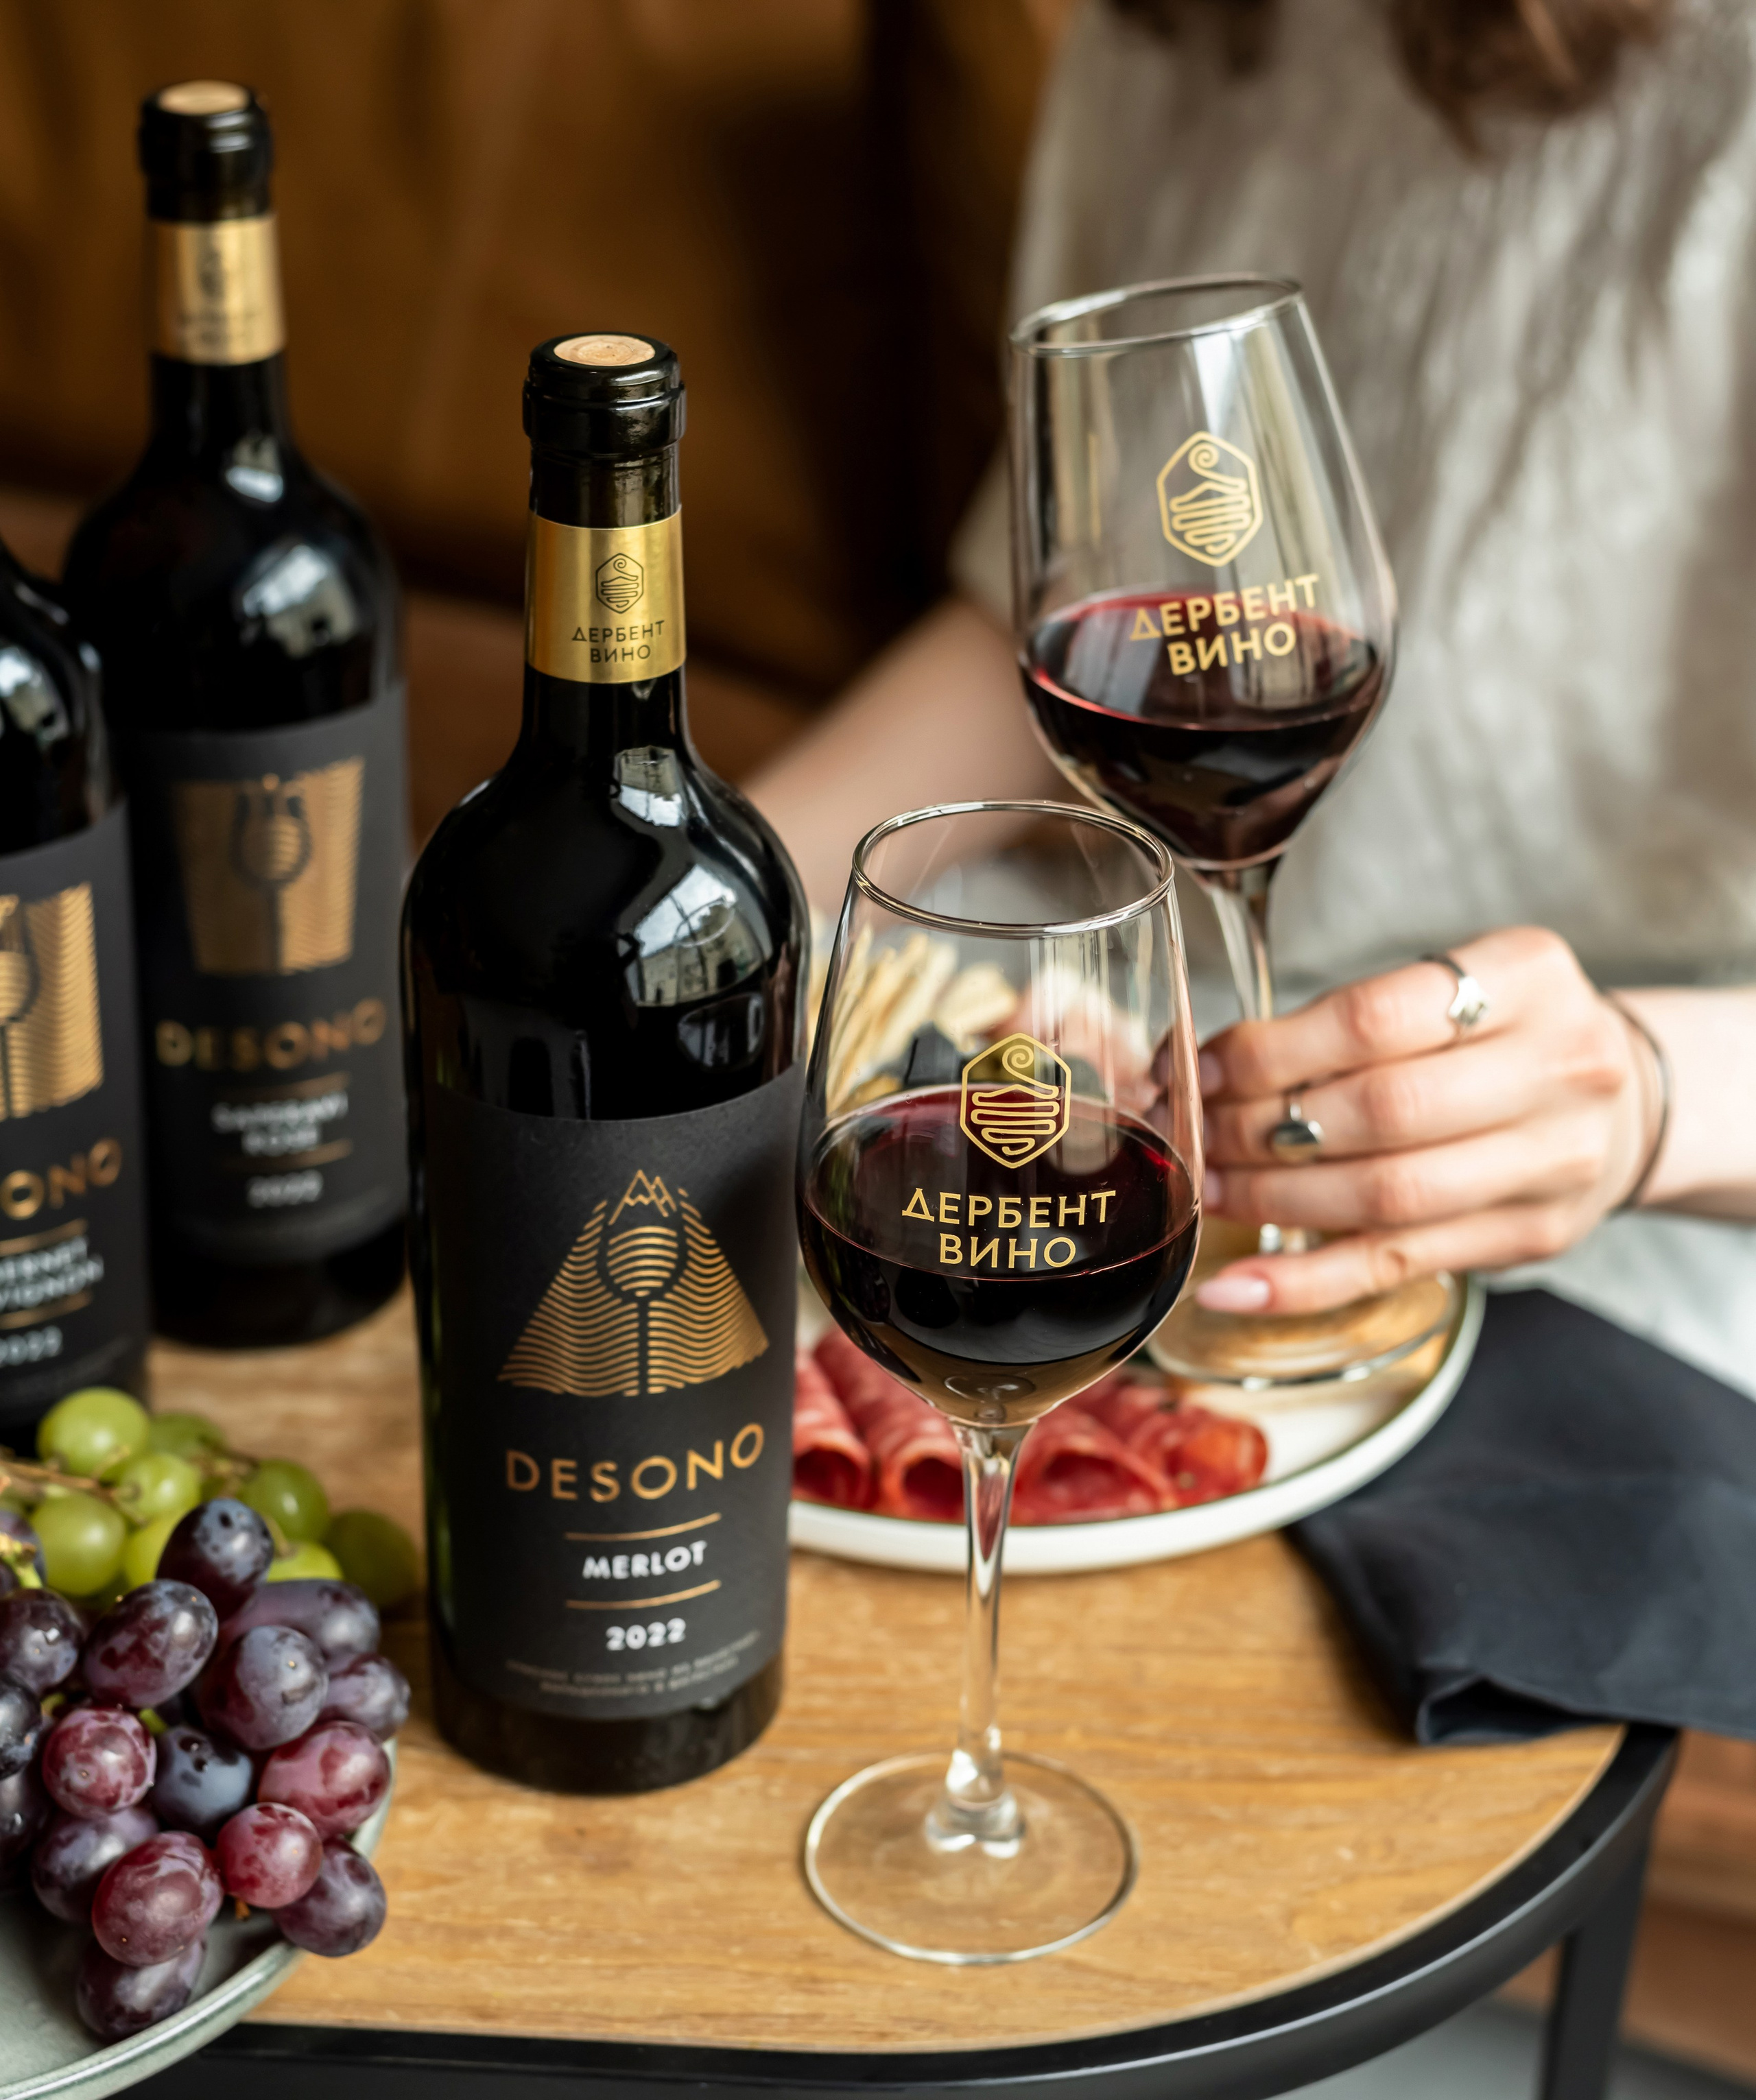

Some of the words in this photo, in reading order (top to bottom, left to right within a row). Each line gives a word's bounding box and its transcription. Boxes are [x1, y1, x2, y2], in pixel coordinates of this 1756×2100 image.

[1130, 573, 1319, 641] ДЕРБЕНТ
[571, 620, 665, 643] ДЕРБЕНТ
[1167, 622, 1296, 676] ВИНО
[590, 645, 651, 663] ВИНО
[156, 998, 385, 1071] DESONO
[902, 1188, 1116, 1228] ДЕРБЕНТ
[940, 1233, 1076, 1268] ВИНО
[506, 1423, 764, 1502] DESONO
[582, 1540, 707, 1579] MERLOT
[606, 1617, 686, 1651] 2022
